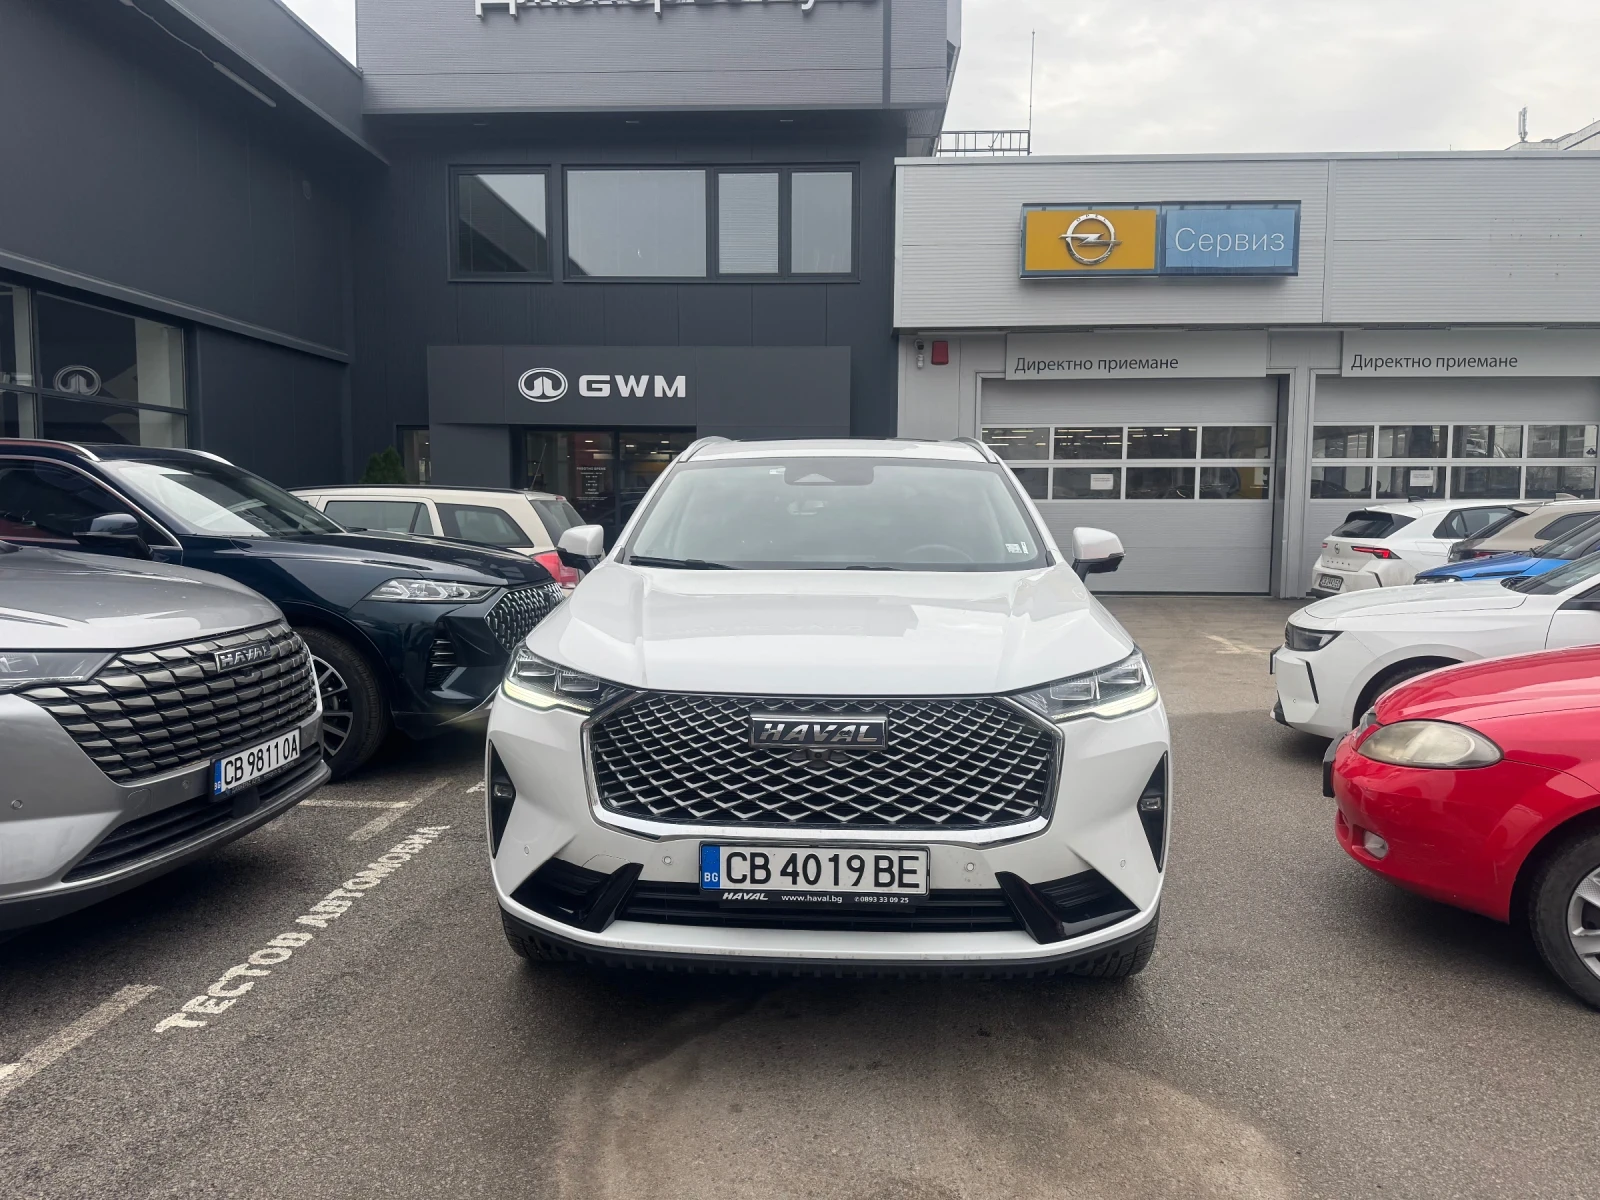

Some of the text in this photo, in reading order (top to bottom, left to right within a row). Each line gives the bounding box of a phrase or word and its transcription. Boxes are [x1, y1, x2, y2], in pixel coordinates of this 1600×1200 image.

[1175, 227, 1285, 258] Сервиз
[1014, 357, 1179, 374] Директно приемане
[1351, 354, 1518, 371] Директно приемане
[579, 375, 686, 398] GWM
[759, 723, 878, 742] HAVAL
[247, 741, 279, 776] 9811
[704, 872, 719, 882] BG
[726, 852, 920, 888] CB 4019 BE
[722, 892, 769, 900] HAVAL
[781, 895, 843, 903] www.haval.bg
[152, 932, 314, 1032] ТЕСТОВ
